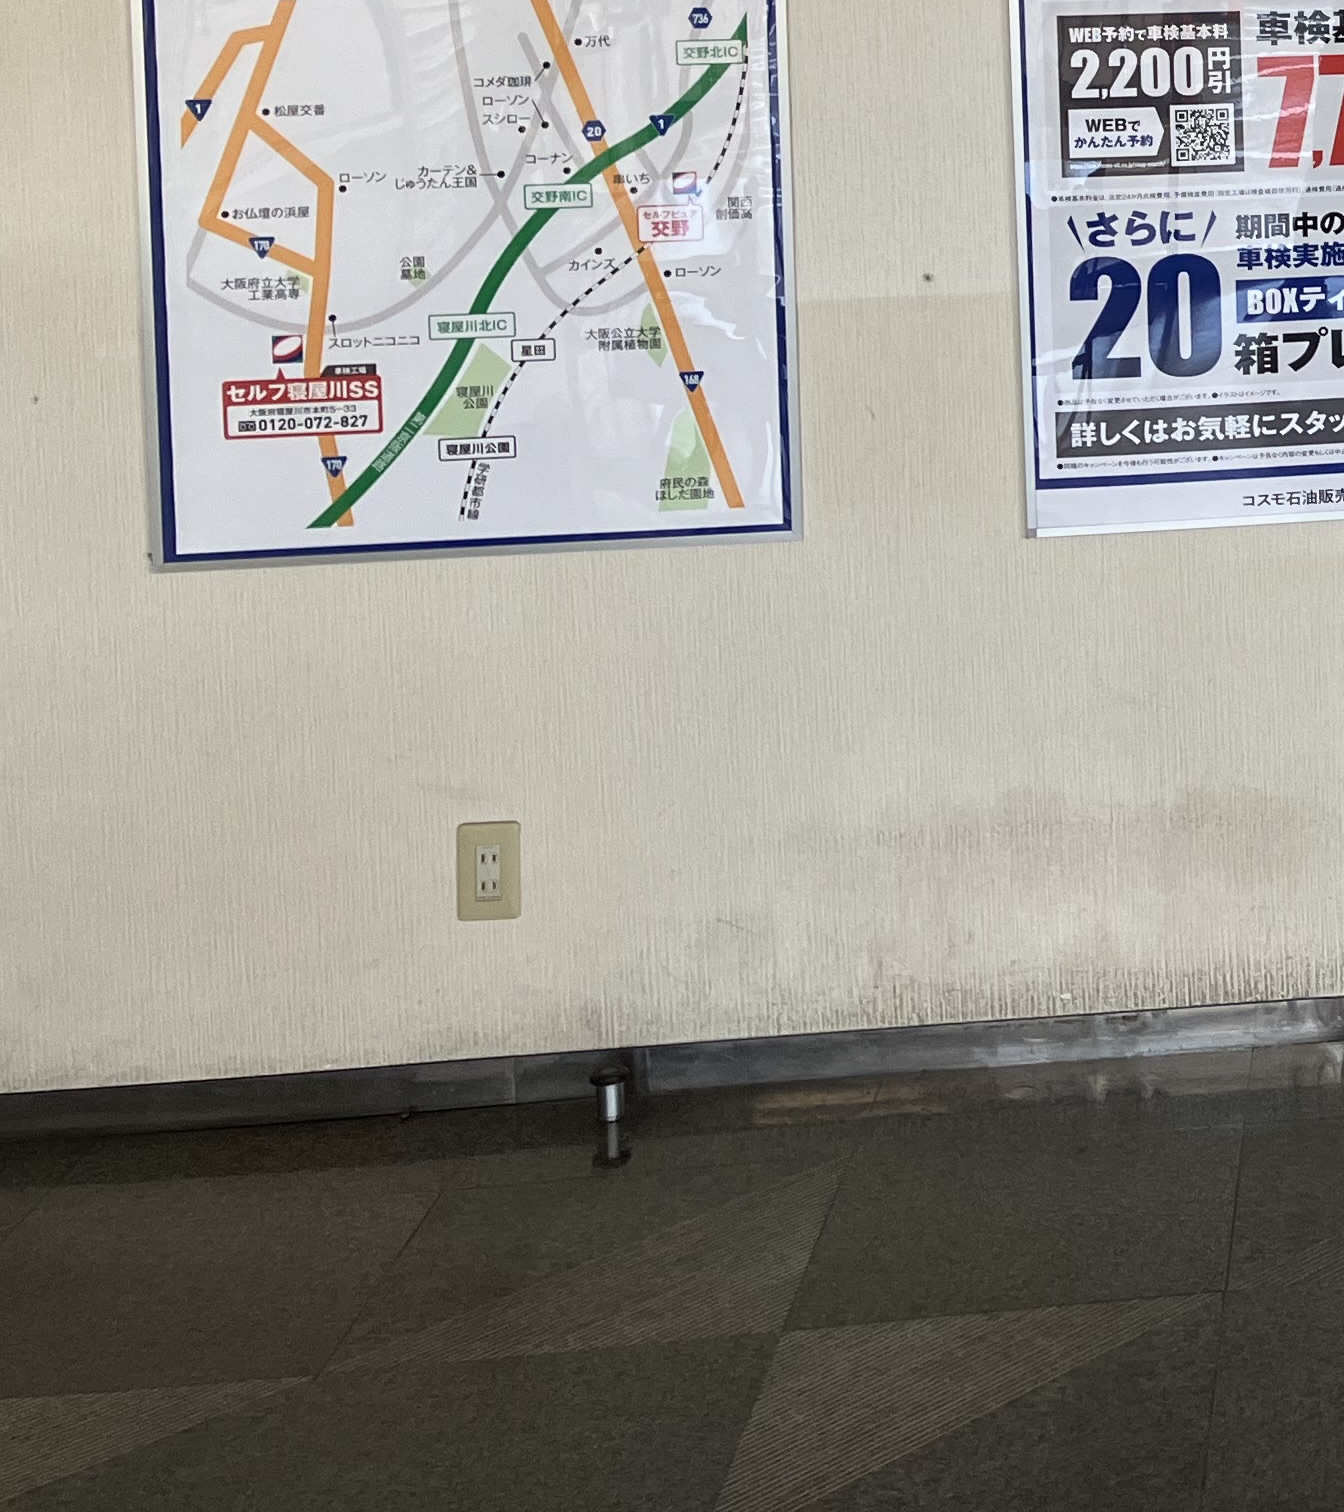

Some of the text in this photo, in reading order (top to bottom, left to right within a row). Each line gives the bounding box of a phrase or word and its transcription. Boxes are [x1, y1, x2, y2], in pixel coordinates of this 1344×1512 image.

[692, 13, 709, 25] 736
[1068, 23, 1229, 43] WEB予約で車検基本料
[584, 35, 611, 48] 万代
[682, 46, 739, 59] 交野北IC
[1069, 46, 1205, 100] 2,200
[1207, 46, 1231, 94] 円引
[472, 76, 533, 88] コメダ珈琲
[482, 95, 530, 107] ローソン
[195, 103, 201, 114] 1
[274, 104, 325, 117] 松屋交番
[481, 113, 532, 125] スシロー
[658, 119, 665, 130] 1
[1085, 118, 1141, 133] WEBで
[586, 126, 603, 138] 20
[1073, 134, 1154, 149] かんたん予約
[525, 152, 573, 164] コーナン
[338, 171, 387, 183] ローソン
[417, 165, 478, 177] カーテン&
[394, 176, 478, 190] じゅうたん王国
[530, 190, 588, 203] 交野南IC
[231, 206, 310, 220] お仏壇の浜屋
[651, 219, 691, 238] 交野
[1086, 210, 1197, 248] さらに
[400, 255, 426, 268] 公園
[568, 259, 616, 272] カインズ
[400, 268, 427, 281] 墓地
[674, 265, 722, 278] ローソン
[220, 277, 300, 291] 大阪府立大学
[247, 289, 300, 301] 工業高専
[1068, 253, 1223, 381] 20
[436, 318, 508, 334] 寝屋川北IC
[585, 326, 662, 340] 大阪公立大学
[328, 335, 421, 349] スロットニコニコ
[520, 344, 546, 356] 星田
[226, 379, 380, 403] セルフ寝屋川SS
[455, 384, 496, 398] 寝屋川
[462, 397, 489, 410] 公園
[258, 414, 369, 432] 0120-072-827
[445, 441, 511, 456] 寝屋川公園
[325, 459, 343, 471] 170
[655, 488, 716, 502] ほしだ園地
